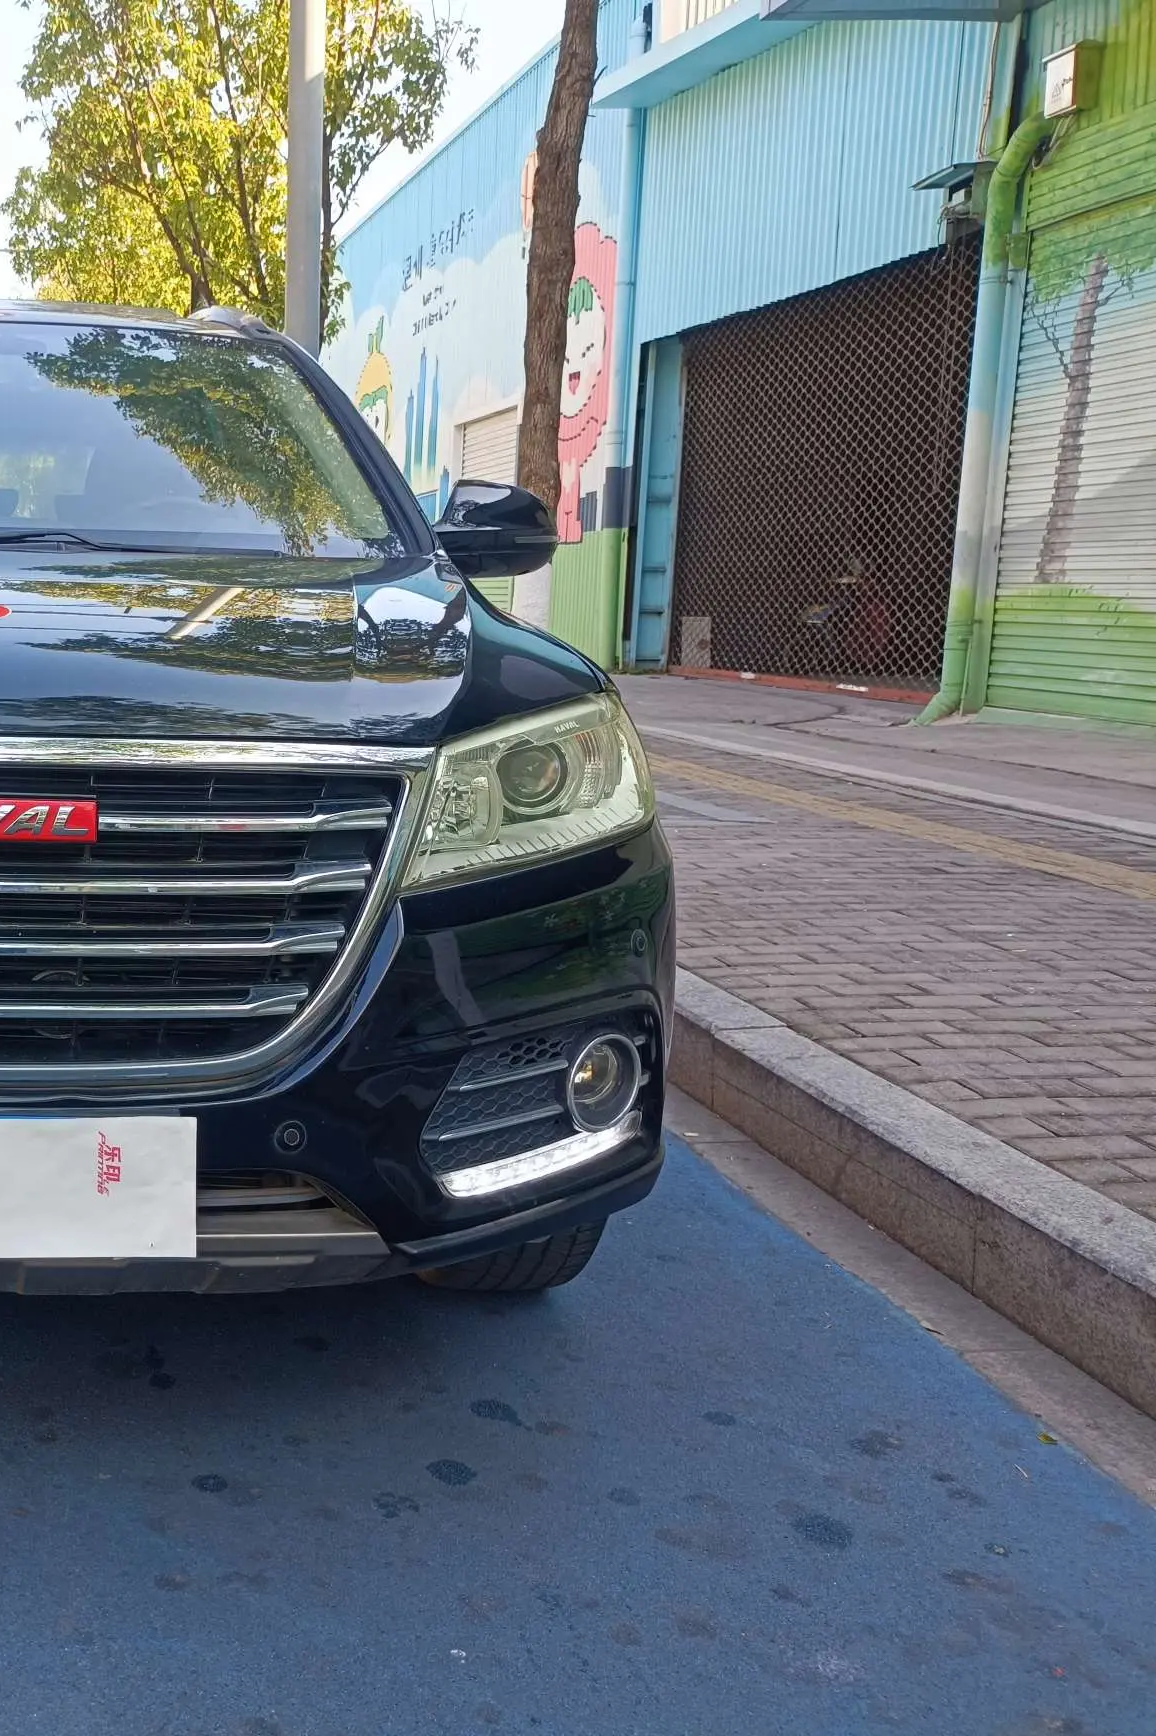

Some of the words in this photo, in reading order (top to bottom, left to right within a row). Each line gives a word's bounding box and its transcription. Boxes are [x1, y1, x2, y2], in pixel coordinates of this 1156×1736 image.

[554, 720, 580, 734] HAVAL
[97, 1131, 107, 1195] PRINTING
[104, 1144, 122, 1183] 乐印
